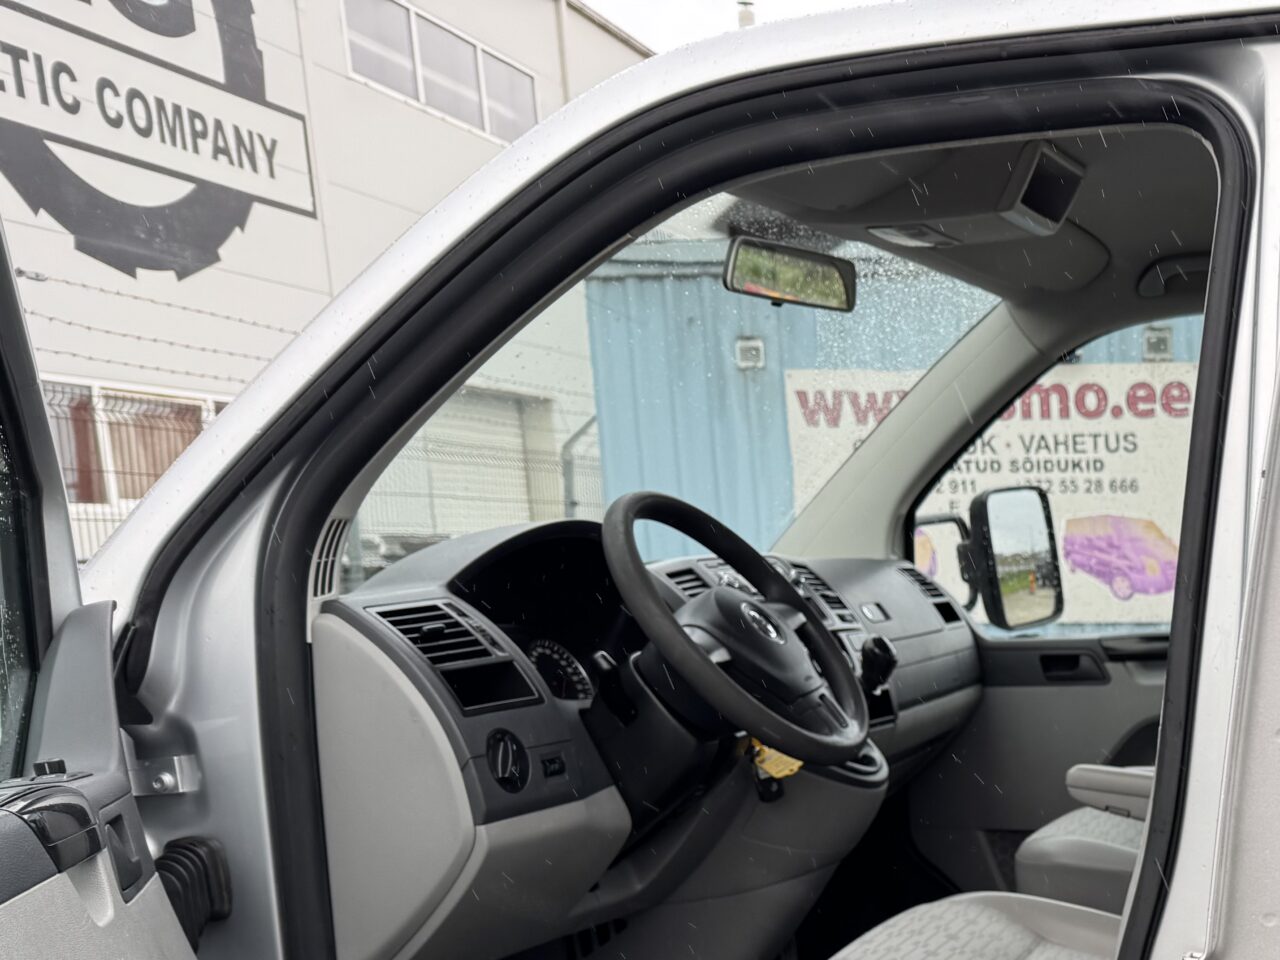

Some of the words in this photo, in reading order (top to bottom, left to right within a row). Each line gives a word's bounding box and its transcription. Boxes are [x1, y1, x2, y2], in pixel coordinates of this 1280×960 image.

[0, 40, 81, 116] TIC
[95, 76, 278, 179] COMPANY
[1019, 432, 1139, 454] VAHETUS
[1009, 455, 1105, 473] SÕIDUKID
[1084, 479, 1104, 494] 28
[1109, 479, 1140, 494] 666
